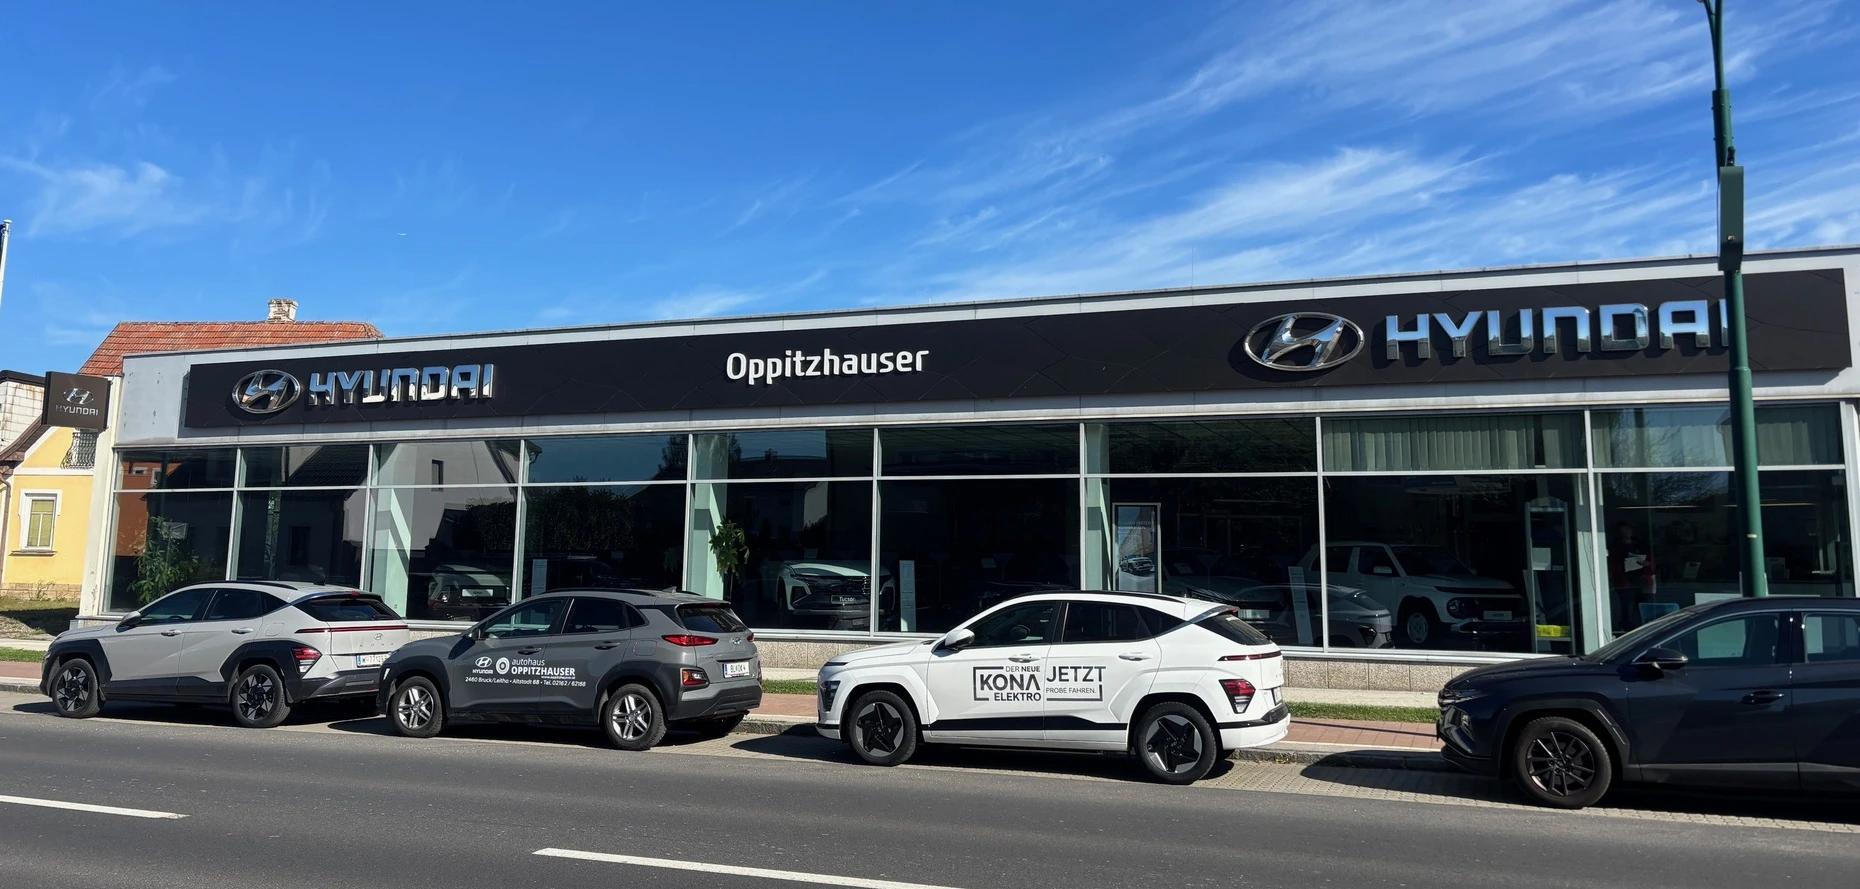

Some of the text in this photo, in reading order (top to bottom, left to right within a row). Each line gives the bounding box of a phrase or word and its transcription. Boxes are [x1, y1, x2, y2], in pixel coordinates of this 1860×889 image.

[726, 348, 930, 385] Oppitzhauser
[308, 364, 495, 406] HYUNDAI
[55, 404, 99, 416] HYUNDAI
[511, 658, 545, 666] autohaus
[511, 666, 575, 676] OPPITZHAUSER
[1021, 665, 1041, 673] NEUE
[1046, 666, 1106, 682] JETZT
[980, 673, 1041, 691] KONA
[994, 692, 1042, 701] ELEKTRO
